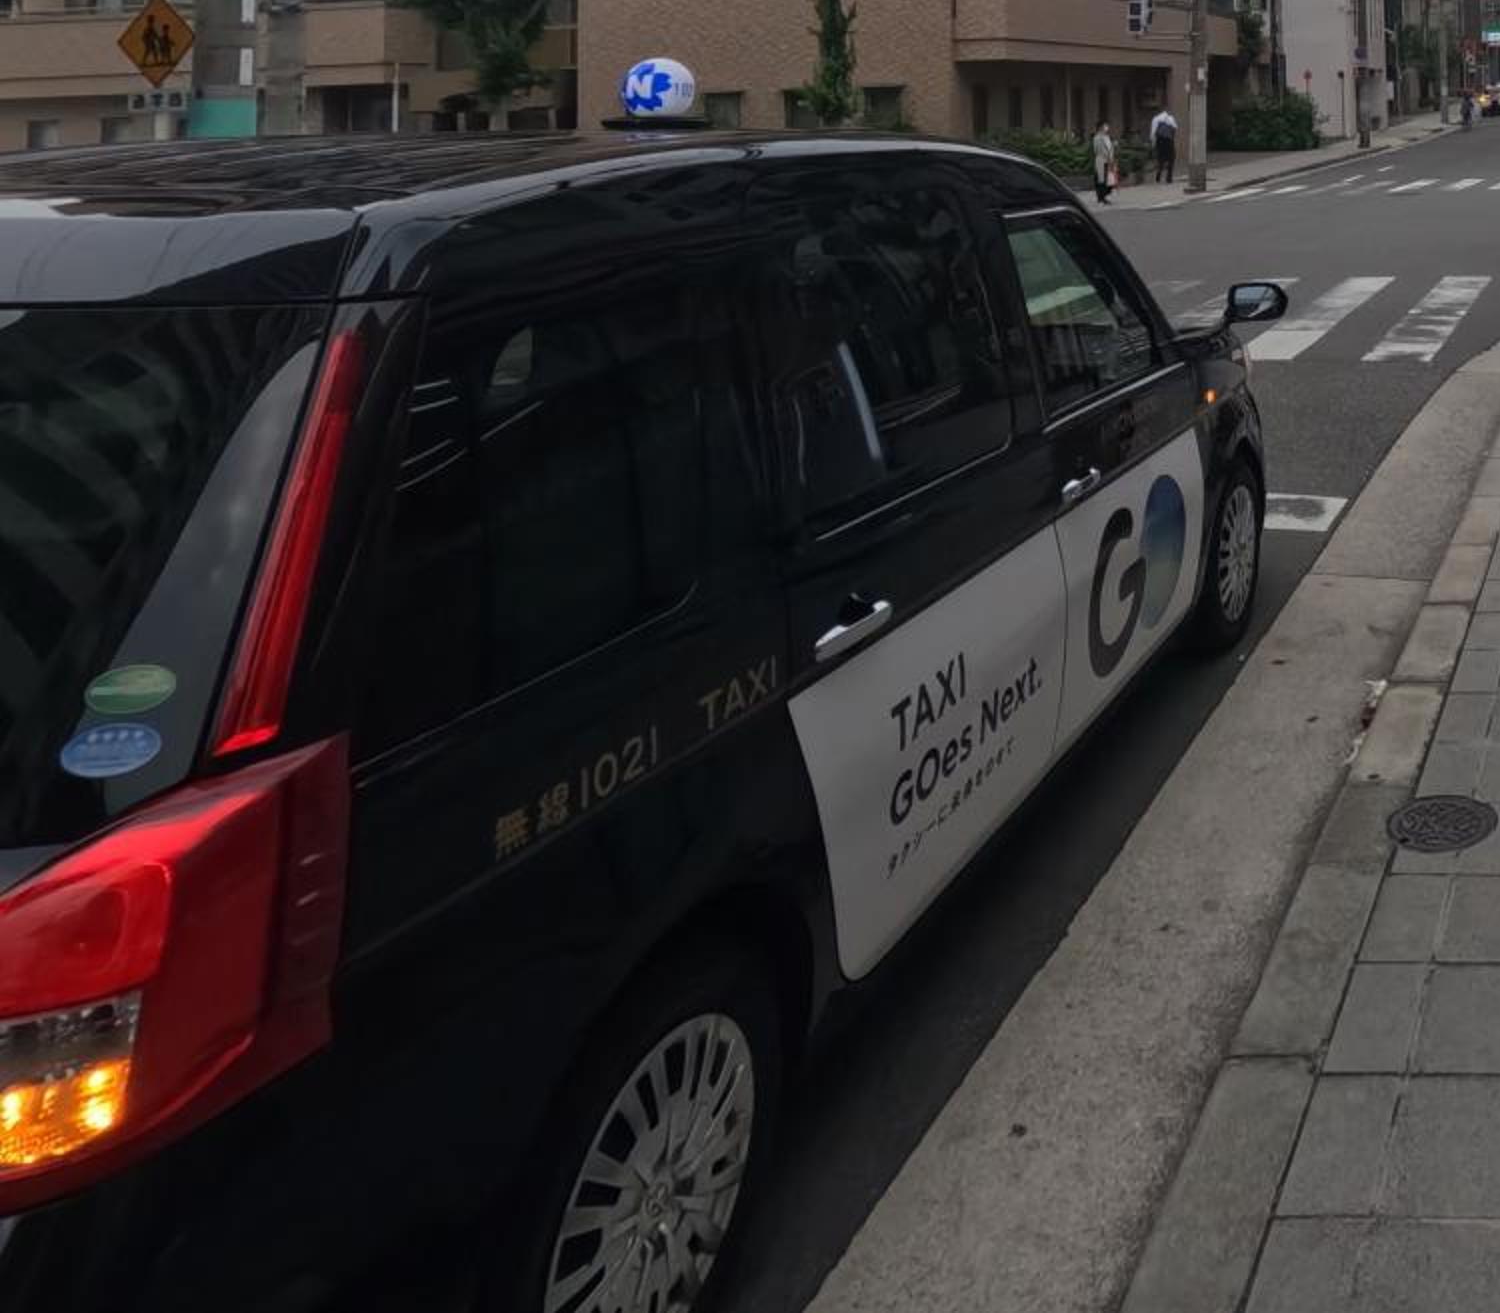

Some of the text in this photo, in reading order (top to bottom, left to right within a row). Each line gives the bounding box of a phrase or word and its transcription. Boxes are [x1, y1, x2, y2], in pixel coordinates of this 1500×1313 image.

[1088, 474, 1187, 678] GO
[698, 654, 780, 732] TAXI
[888, 654, 1044, 826] GOes Next.
[890, 650, 967, 751] TAXI
